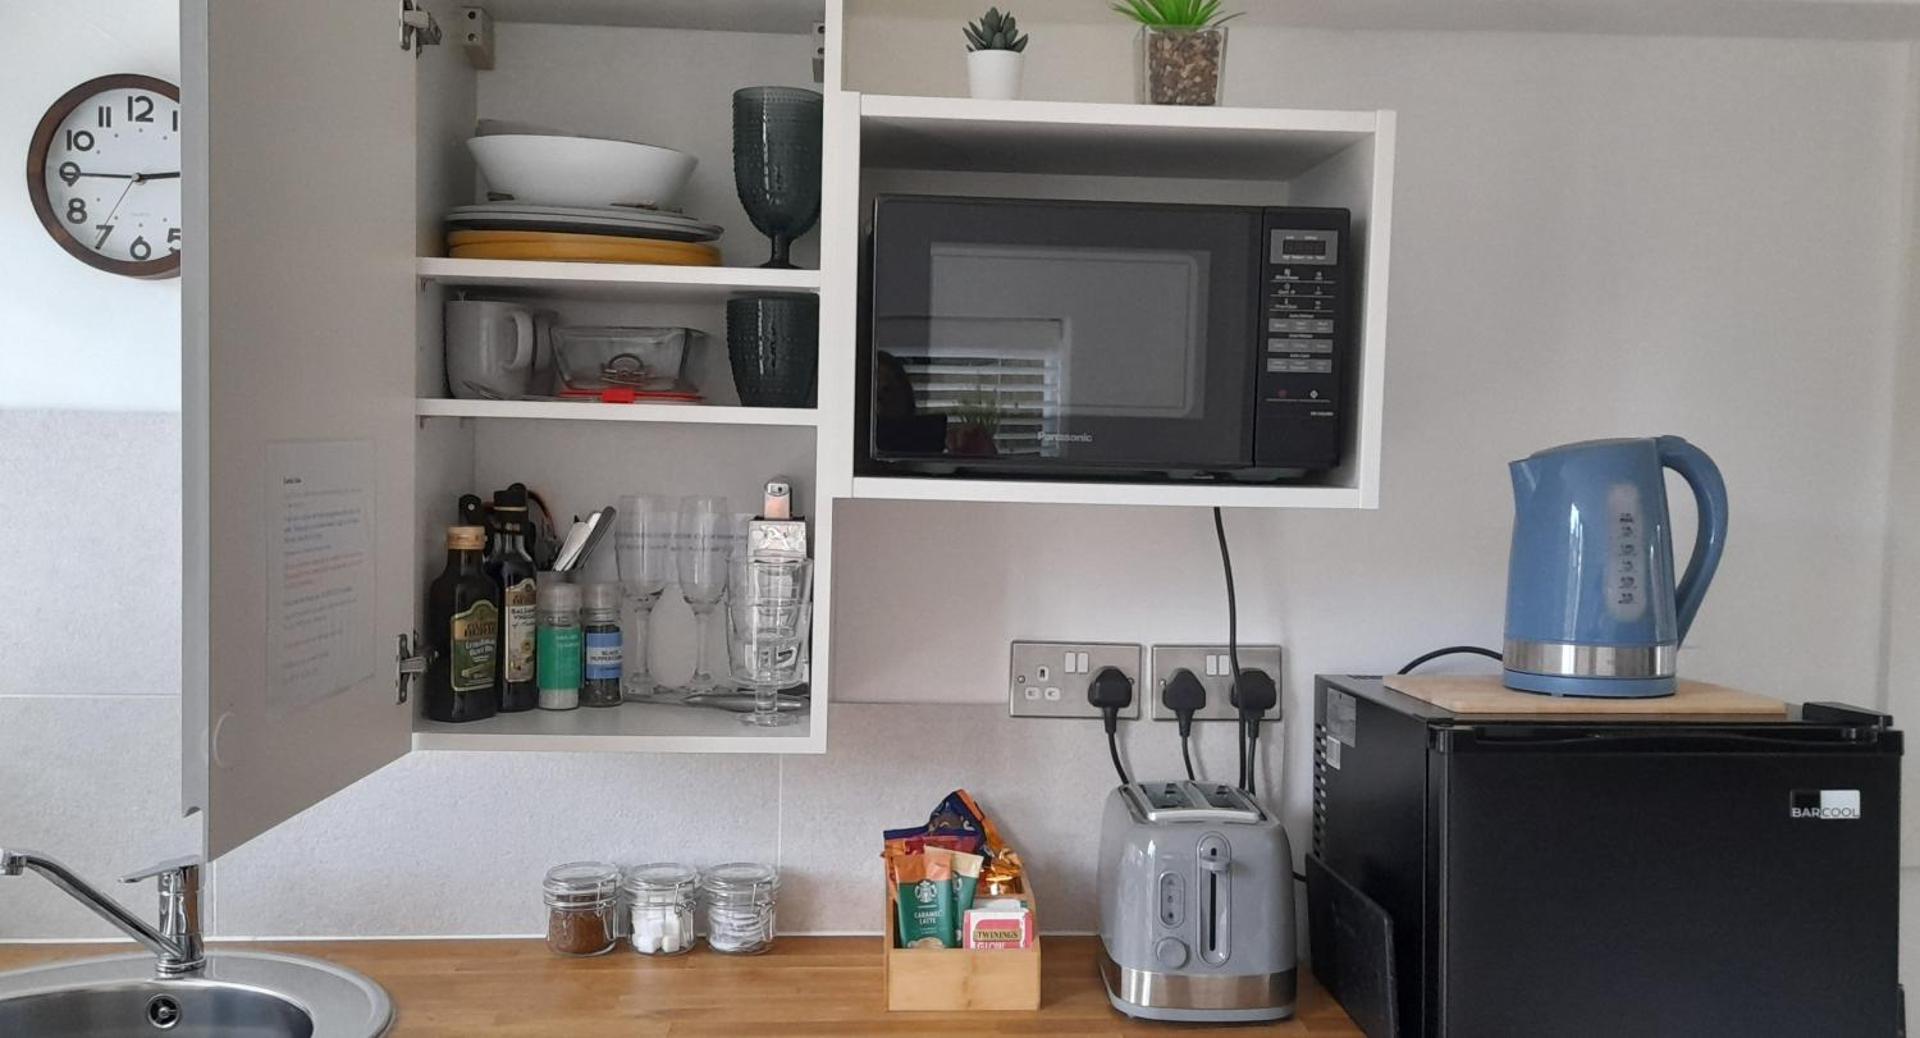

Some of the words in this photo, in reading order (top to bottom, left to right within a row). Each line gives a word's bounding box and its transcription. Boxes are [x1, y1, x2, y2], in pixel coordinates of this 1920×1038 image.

[98, 106, 111, 128] 11
[128, 96, 154, 122] 12
[66, 129, 95, 151] 10
[59, 161, 81, 187] 9
[66, 198, 88, 224] 8
[94, 225, 114, 250] 7
[130, 235, 151, 261] 6
[1037, 431, 1093, 442] Panasonic
[1791, 807, 1860, 818] BARCOOL
[914, 910, 942, 919] CARAMEL
[919, 917, 936, 925] LATTE
[977, 931, 1018, 939] TWININGS
